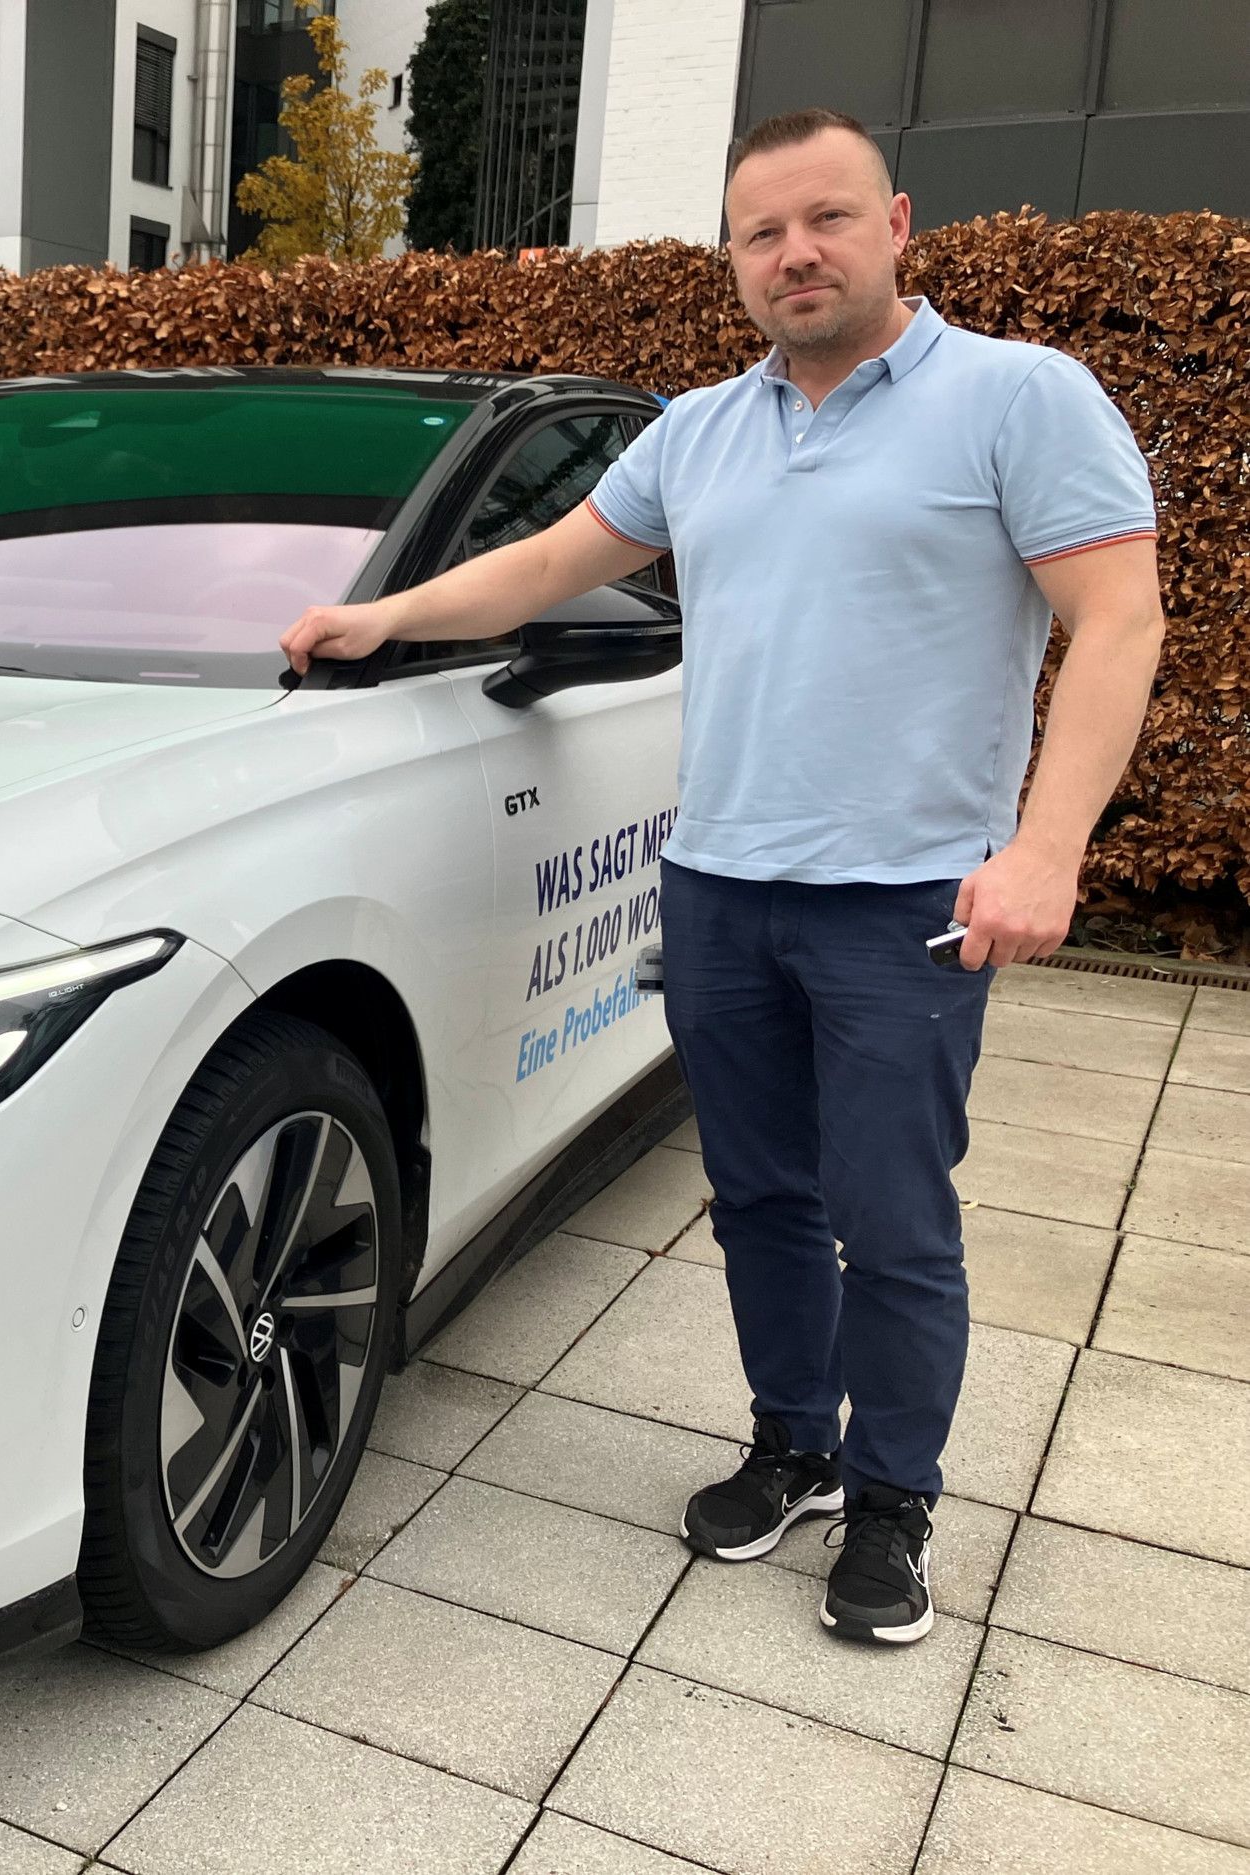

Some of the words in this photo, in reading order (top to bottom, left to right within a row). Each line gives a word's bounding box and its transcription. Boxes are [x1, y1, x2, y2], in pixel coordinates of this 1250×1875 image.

[504, 786, 541, 817] GTX
[535, 846, 582, 916] WAS
[589, 823, 638, 892] SAGT
[641, 806, 679, 868] MEH
[526, 932, 568, 1002] ALS
[573, 904, 622, 976] 1.000
[515, 1028, 558, 1084] Eine
